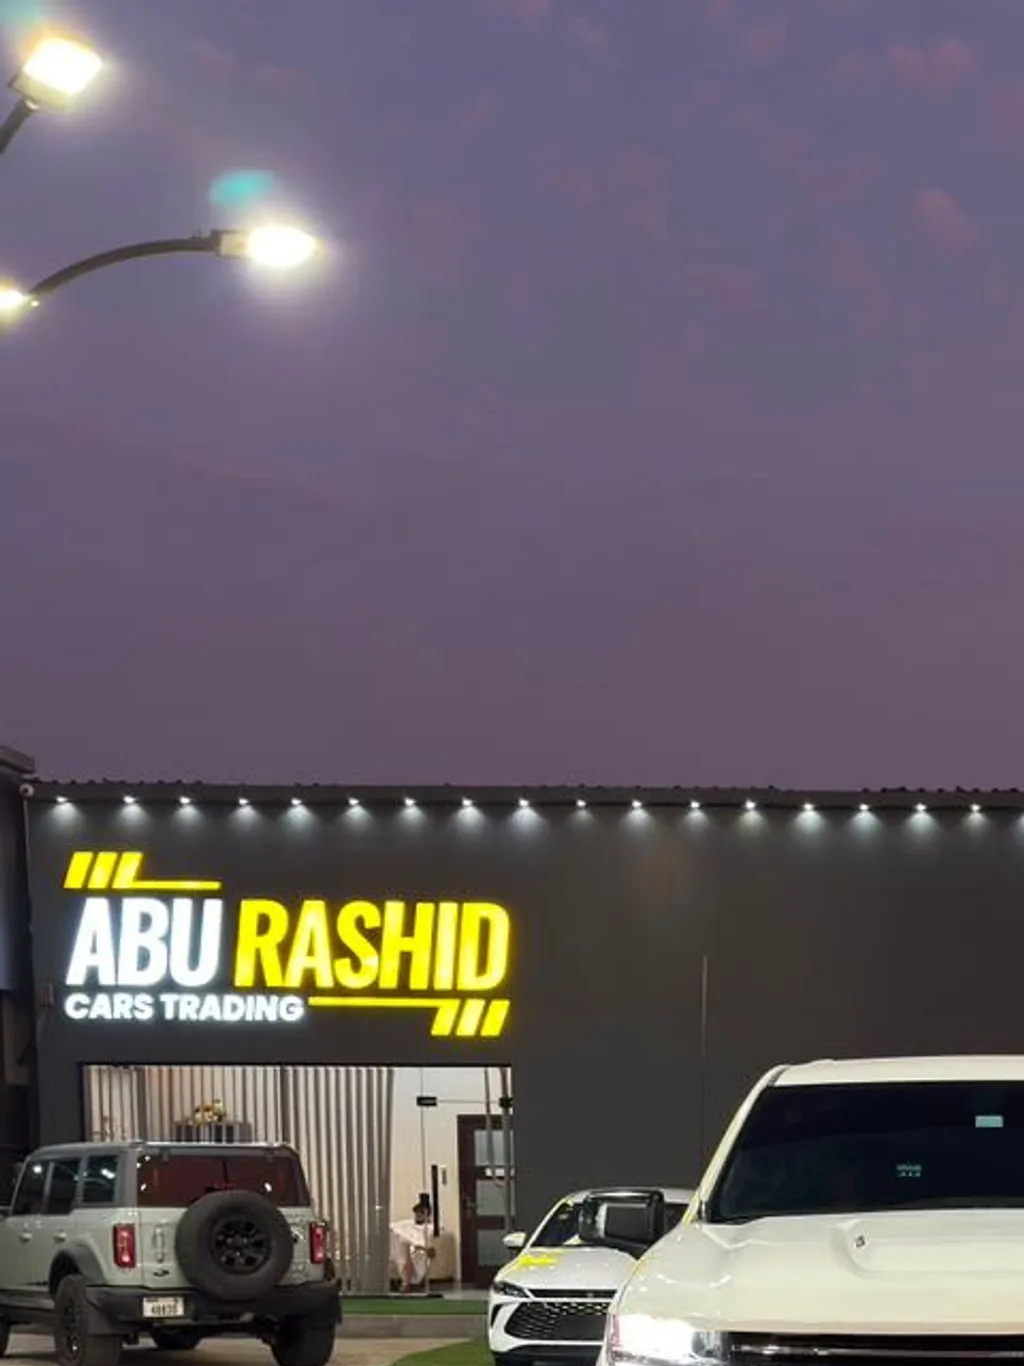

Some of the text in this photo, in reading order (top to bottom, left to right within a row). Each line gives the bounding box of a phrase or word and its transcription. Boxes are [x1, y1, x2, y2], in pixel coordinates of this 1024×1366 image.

[64, 898, 511, 991] ABU RASHID
[64, 993, 306, 1022] CARS TRADING
